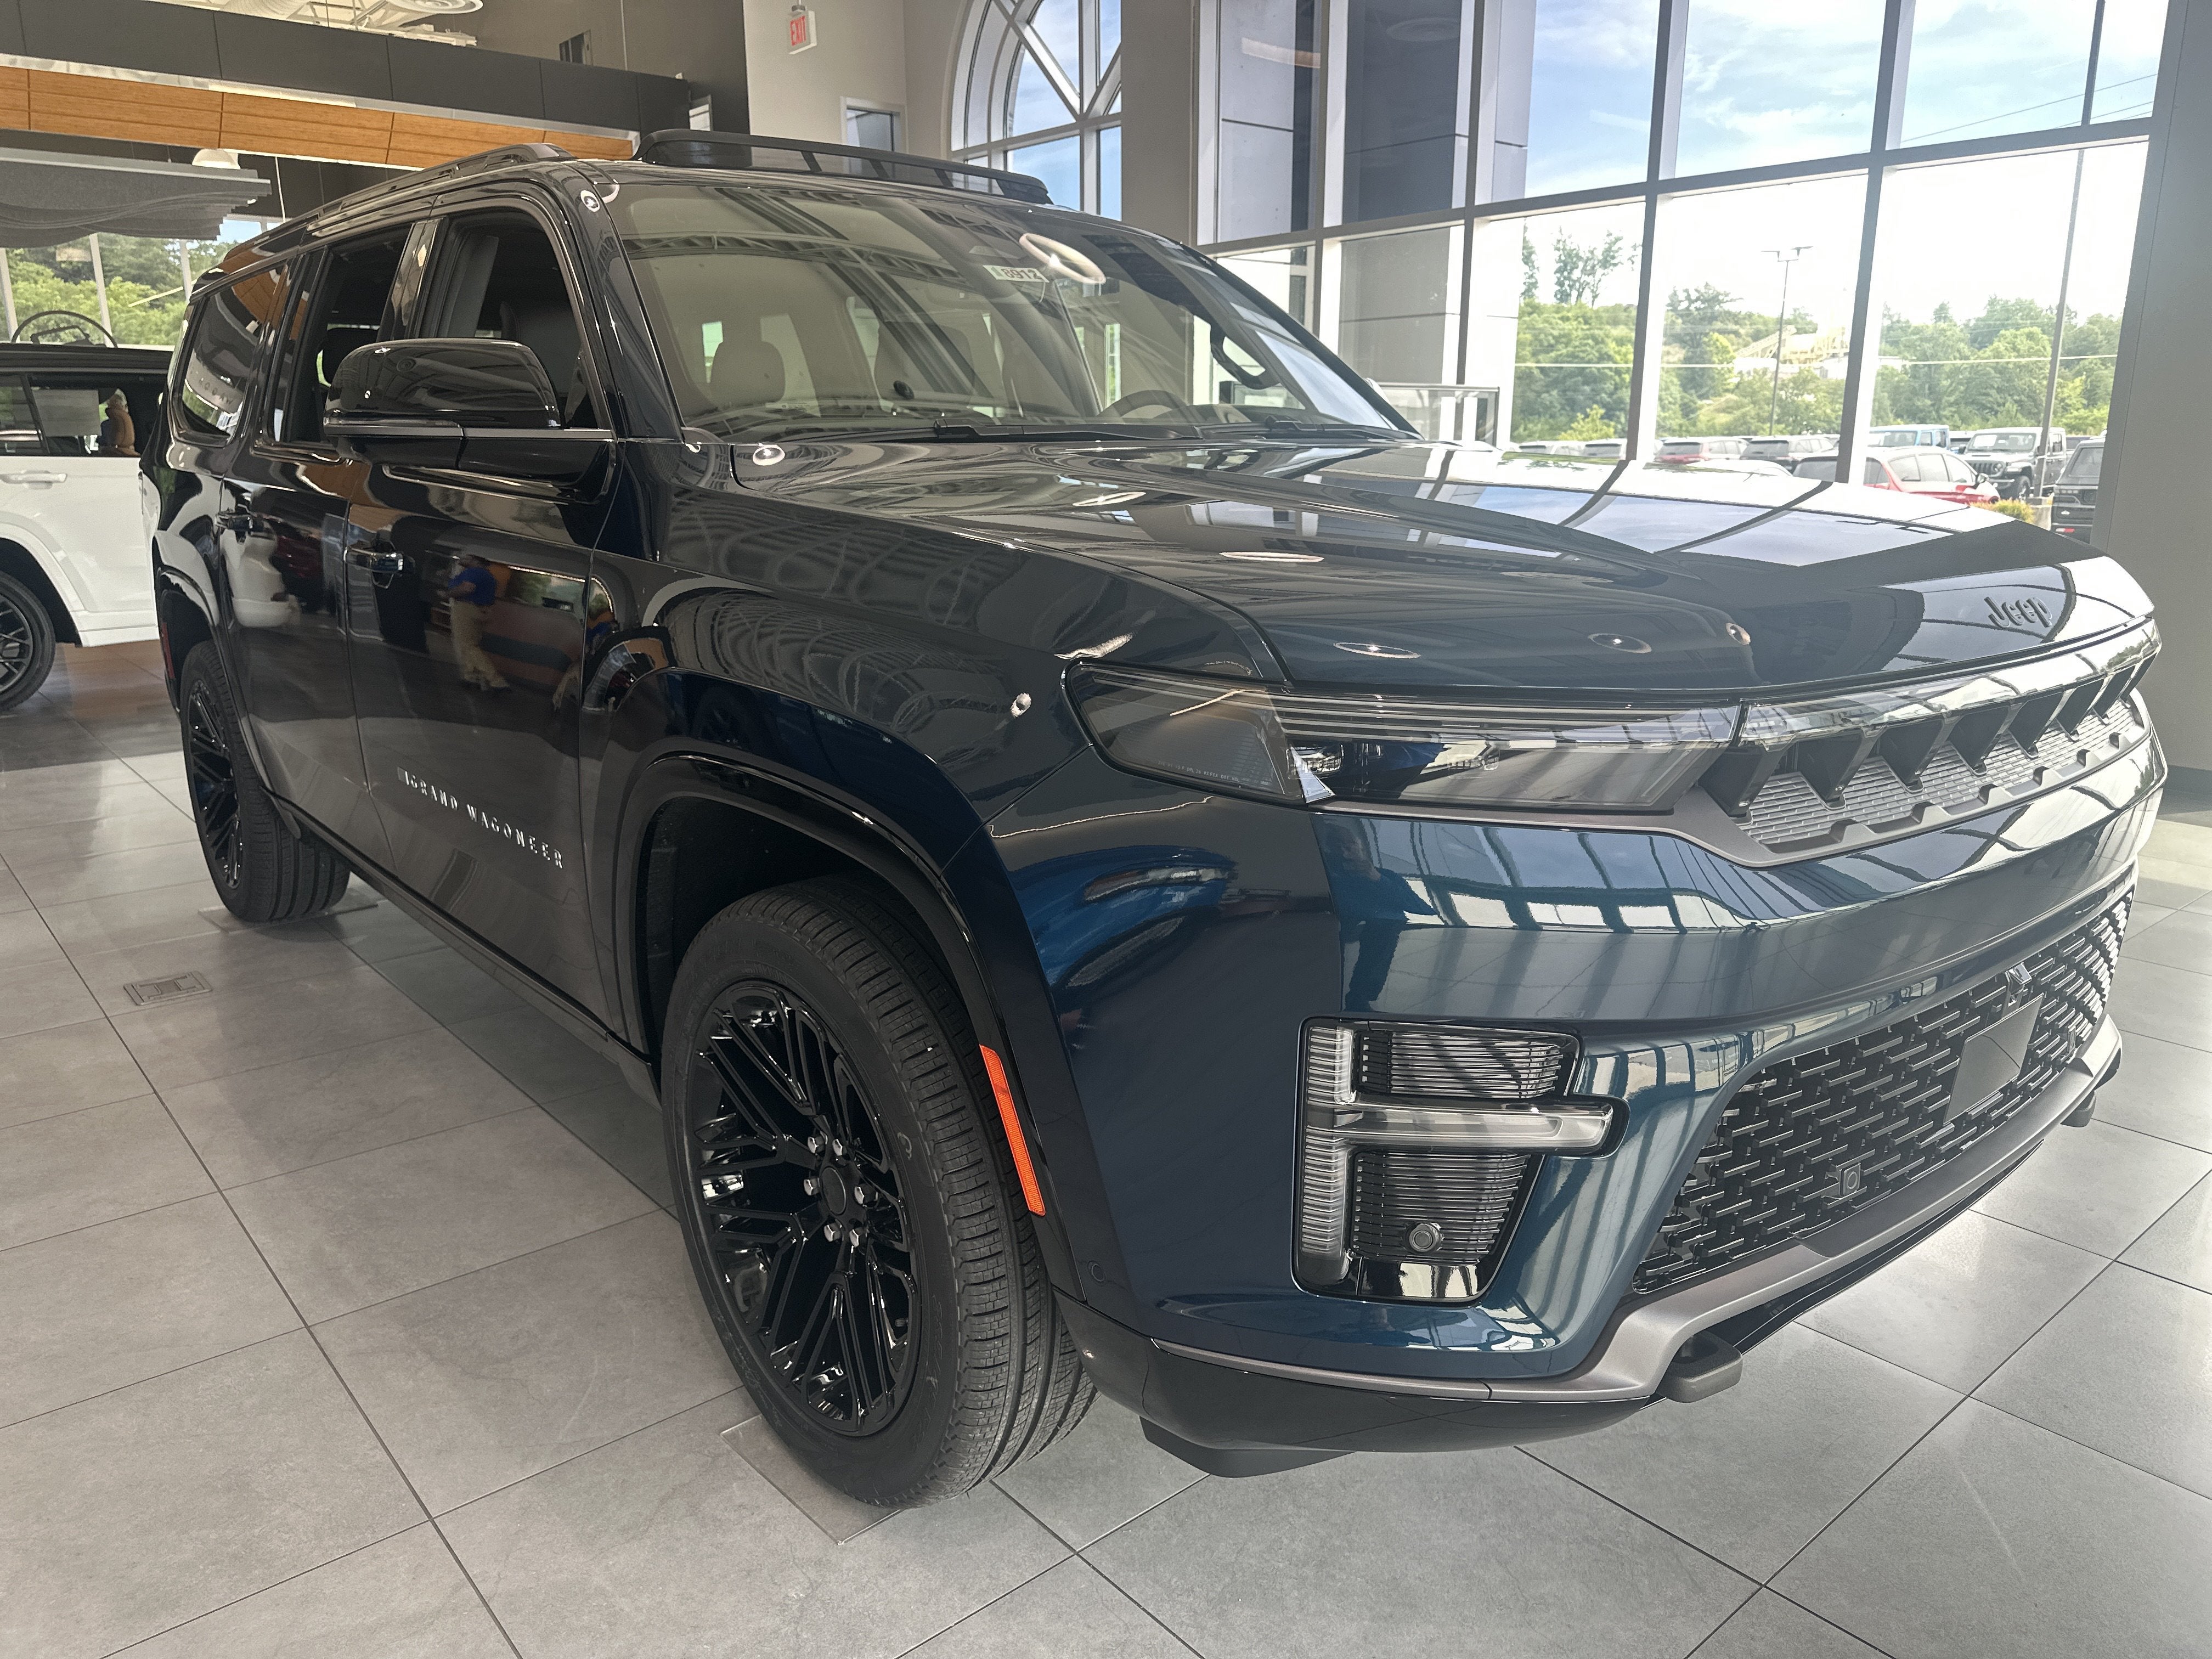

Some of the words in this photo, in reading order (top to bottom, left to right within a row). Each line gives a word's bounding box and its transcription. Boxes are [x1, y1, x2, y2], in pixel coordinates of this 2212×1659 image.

[790, 15, 806, 47] EXIT
[1984, 596, 2053, 629] Jeep
[410, 774, 459, 811] GRAND
[466, 804, 563, 869] WAGONEER
